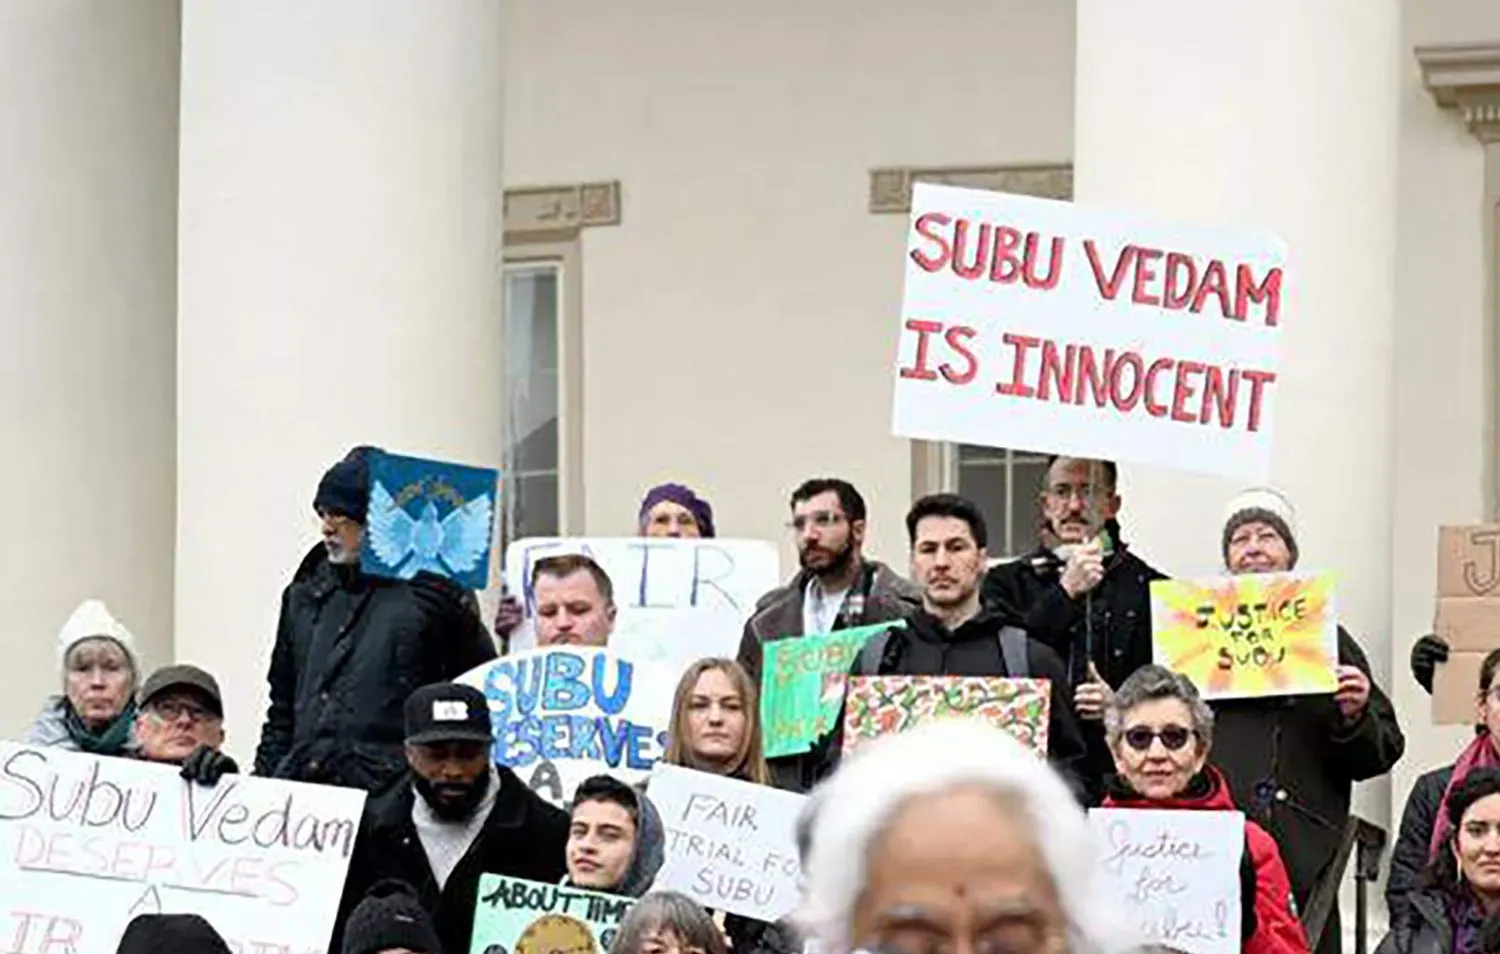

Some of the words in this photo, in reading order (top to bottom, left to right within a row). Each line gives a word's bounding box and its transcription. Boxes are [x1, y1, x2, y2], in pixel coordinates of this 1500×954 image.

[910, 212, 1066, 290] SUBU
[1083, 239, 1283, 327] VEDAM
[900, 318, 979, 386] IS
[996, 332, 1277, 433] INNOCENT
[522, 542, 744, 619] FIR
[1196, 598, 1307, 630] JUSTICE
[484, 651, 634, 716] SUBU
[0, 749, 156, 832] Subu
[186, 776, 355, 857] Vedam
[682, 793, 759, 831] FAIR
[14, 826, 300, 906] DESERVES
[665, 827, 745, 868] TRIAL
[762, 851, 801, 879] FO
[481, 879, 575, 914] ABOUT
[691, 869, 776, 907] SUBU
